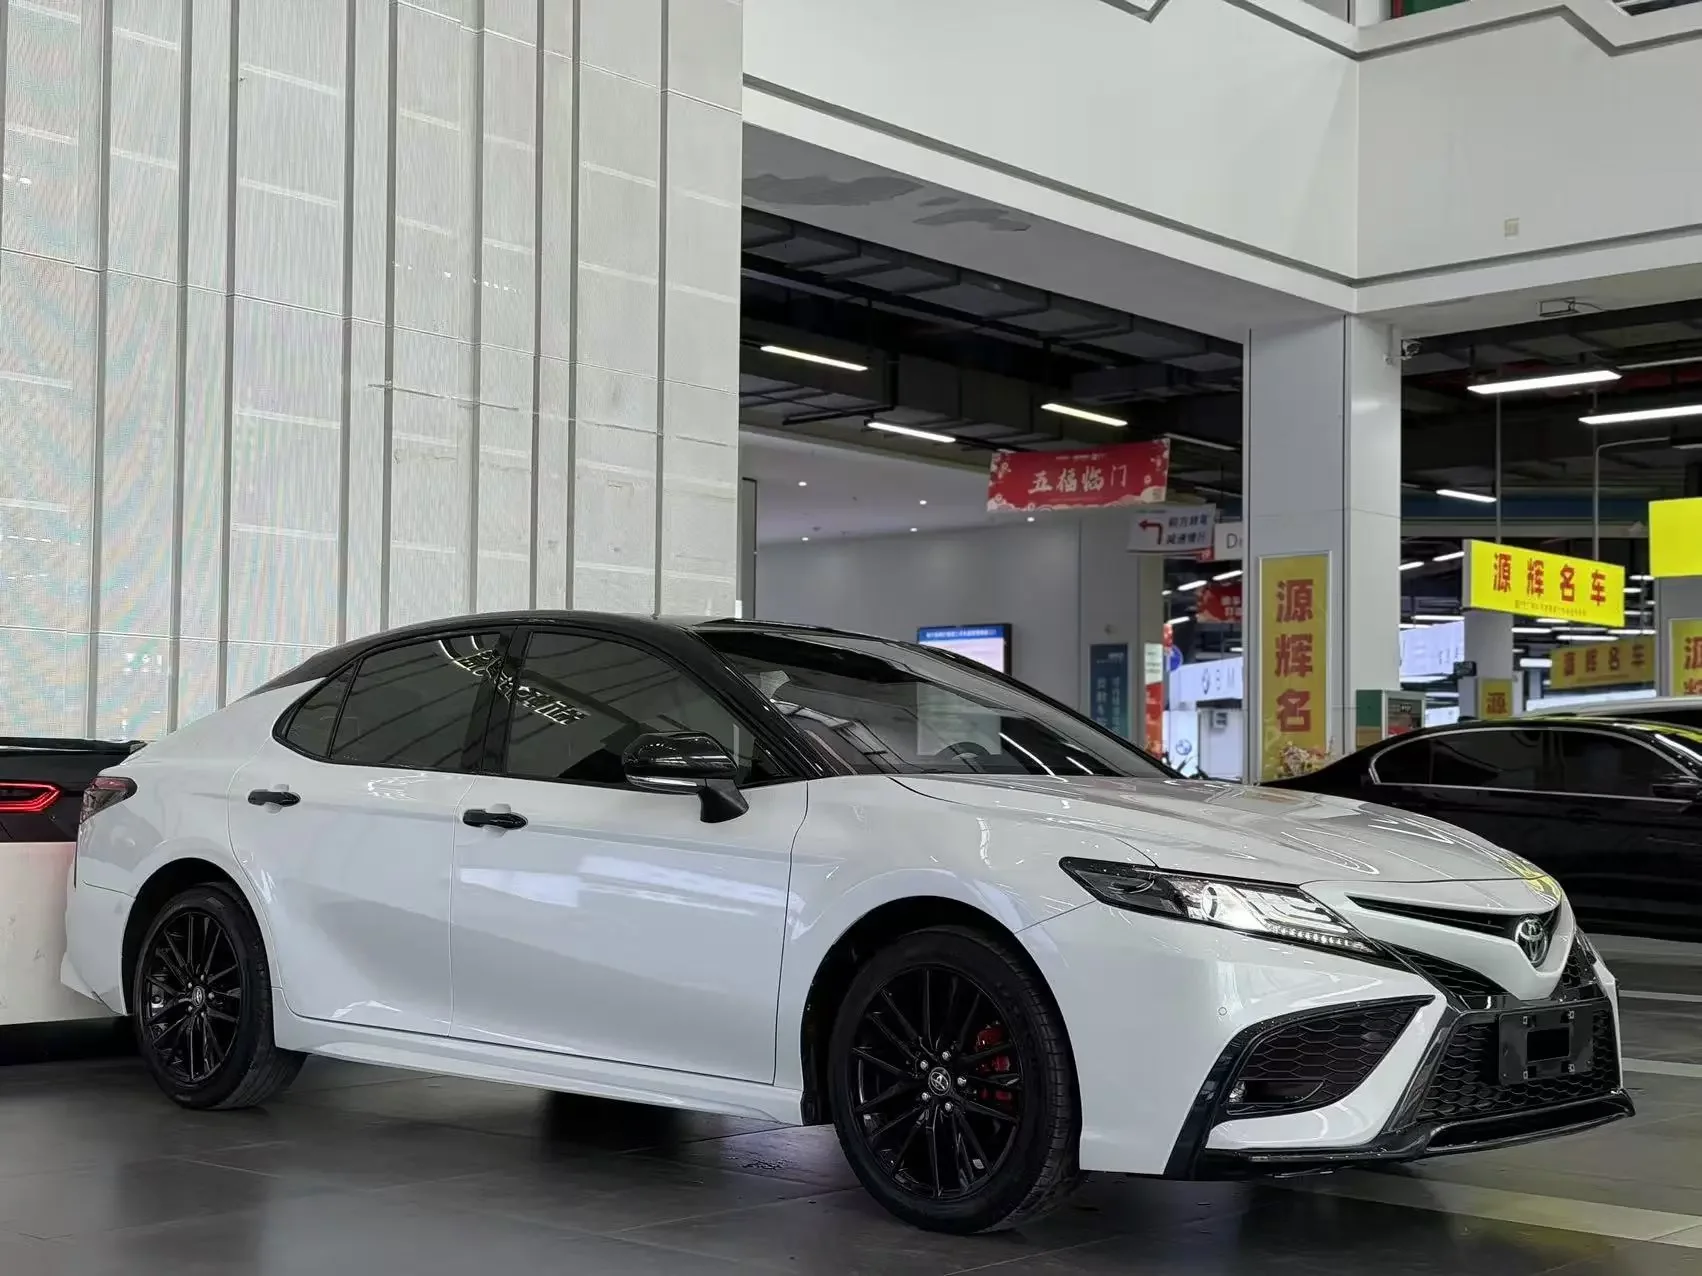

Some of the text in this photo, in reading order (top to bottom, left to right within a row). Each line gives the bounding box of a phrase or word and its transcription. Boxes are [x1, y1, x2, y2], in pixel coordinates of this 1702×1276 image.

[1027, 464, 1128, 495] 五福临门
[1493, 552, 1607, 606] 源辉名车
